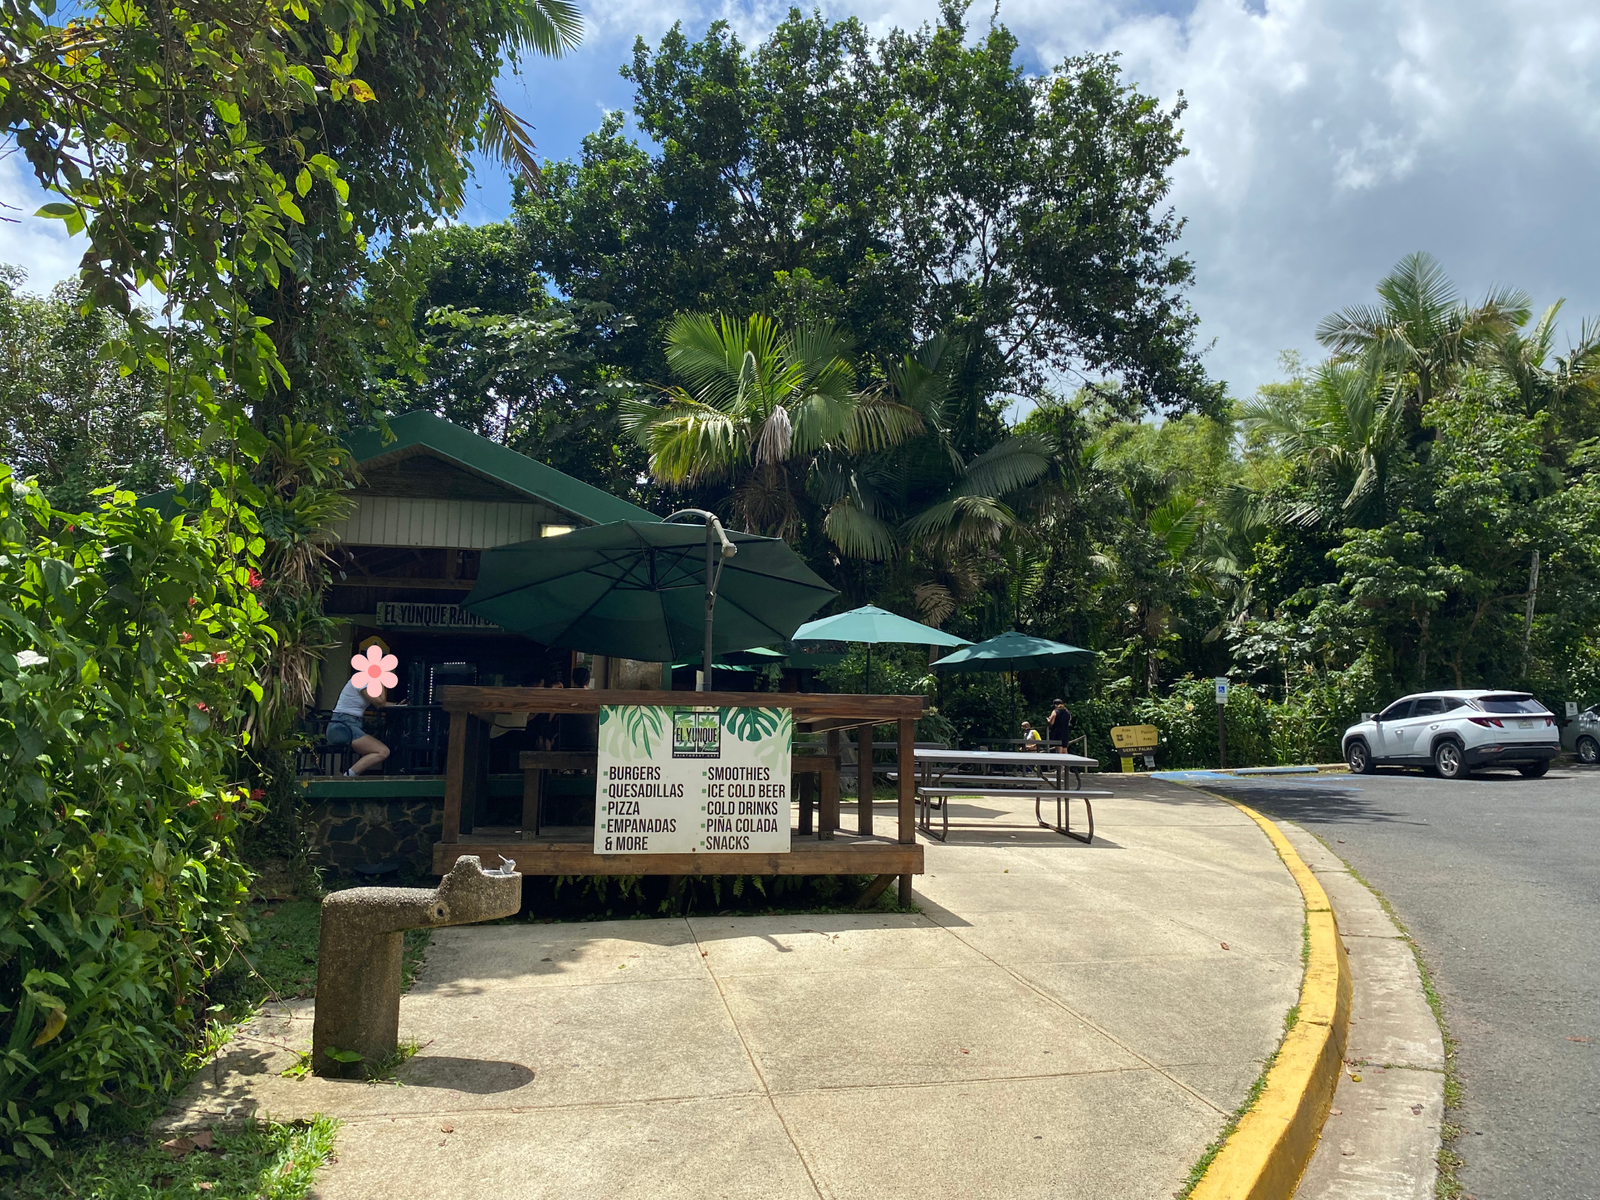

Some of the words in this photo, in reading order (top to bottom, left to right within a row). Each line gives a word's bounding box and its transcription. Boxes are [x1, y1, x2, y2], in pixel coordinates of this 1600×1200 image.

[384, 604, 397, 623] EL
[401, 605, 447, 627] YUNQUE
[449, 606, 498, 626] RAIN
[676, 728, 684, 742] EL
[686, 728, 717, 744] YUNQUE
[609, 766, 661, 781] BURGERS
[707, 766, 770, 781] SMOOTHIES
[608, 783, 684, 799] QUESADILLAS
[707, 784, 724, 798] ICE
[727, 784, 755, 798] COLD
[758, 784, 786, 799] BEER
[607, 801, 640, 816] PIZZA
[707, 801, 735, 816] COLD
[738, 801, 778, 816] DRINKS
[606, 818, 677, 834] EMPANADAS
[706, 815, 732, 833] PIÑA
[735, 818, 778, 833] COLADA
[605, 836, 612, 851] &
[616, 836, 648, 851] MORE
[705, 835, 750, 850] SNACKS
